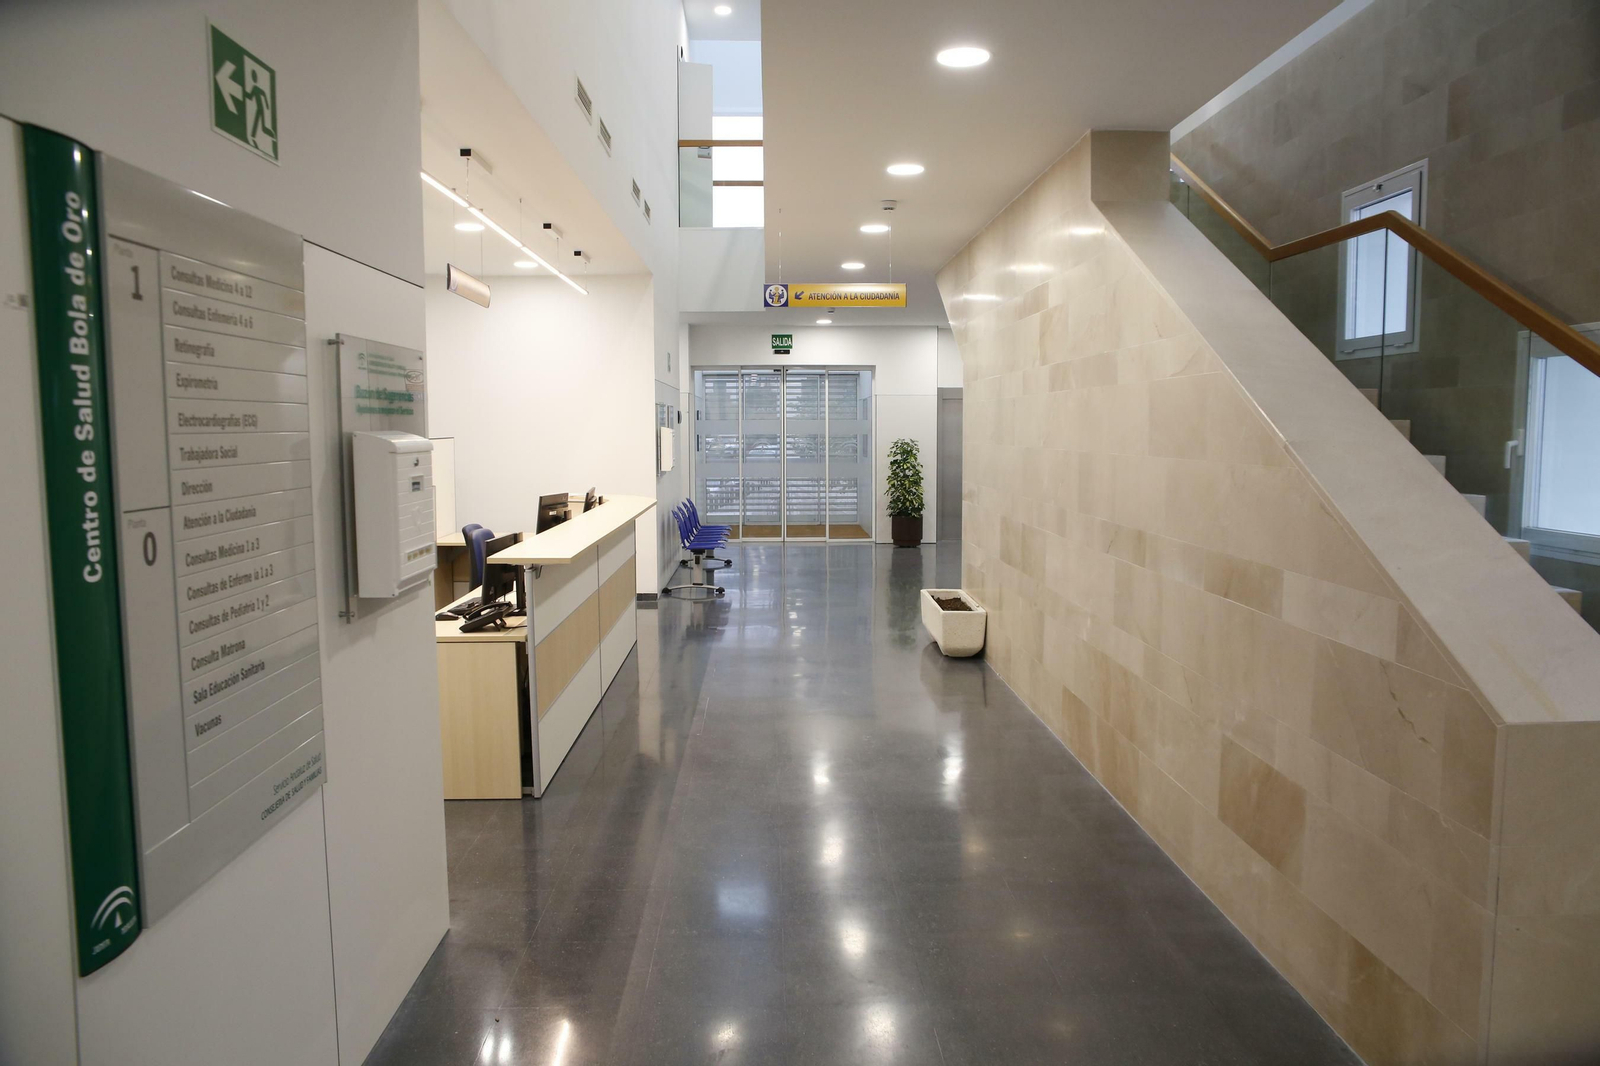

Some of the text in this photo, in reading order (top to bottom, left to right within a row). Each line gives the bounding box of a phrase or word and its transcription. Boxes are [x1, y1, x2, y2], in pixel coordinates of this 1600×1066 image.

[131, 265, 143, 301] 1
[171, 266, 204, 287] Consultas
[206, 274, 233, 294] Medicina
[234, 283, 239, 295] 4
[245, 285, 252, 298] 12
[808, 291, 841, 300] ATENCIÓN
[860, 291, 900, 300] CIUDADANÍA
[172, 301, 206, 320] Consultas
[239, 315, 243, 327] 4
[249, 316, 253, 329] 6
[772, 337, 793, 347] SALIDA
[62, 191, 102, 583] Centro de Salud Bola de Oro
[179, 446, 238, 464] Trabajadora Social
[181, 480, 213, 496] Dirección
[183, 512, 211, 530] Atención
[213, 515, 217, 525] a
[218, 512, 224, 524] la
[143, 531, 157, 566] 0
[185, 549, 217, 567] Consultas
[218, 542, 245, 559] Medicina
[255, 538, 260, 550] 3
[187, 582, 219, 601] Consultas
[220, 578, 228, 592] de
[269, 564, 274, 576] 3
[189, 614, 220, 635] Consultas
[221, 609, 229, 623] de
[261, 600, 265, 612] y
[265, 594, 270, 607] 2
[191, 640, 246, 671] Consulta Matrona
[193, 659, 265, 704] Sala Educación Sanitaria
[194, 714, 222, 737] Vacunas
